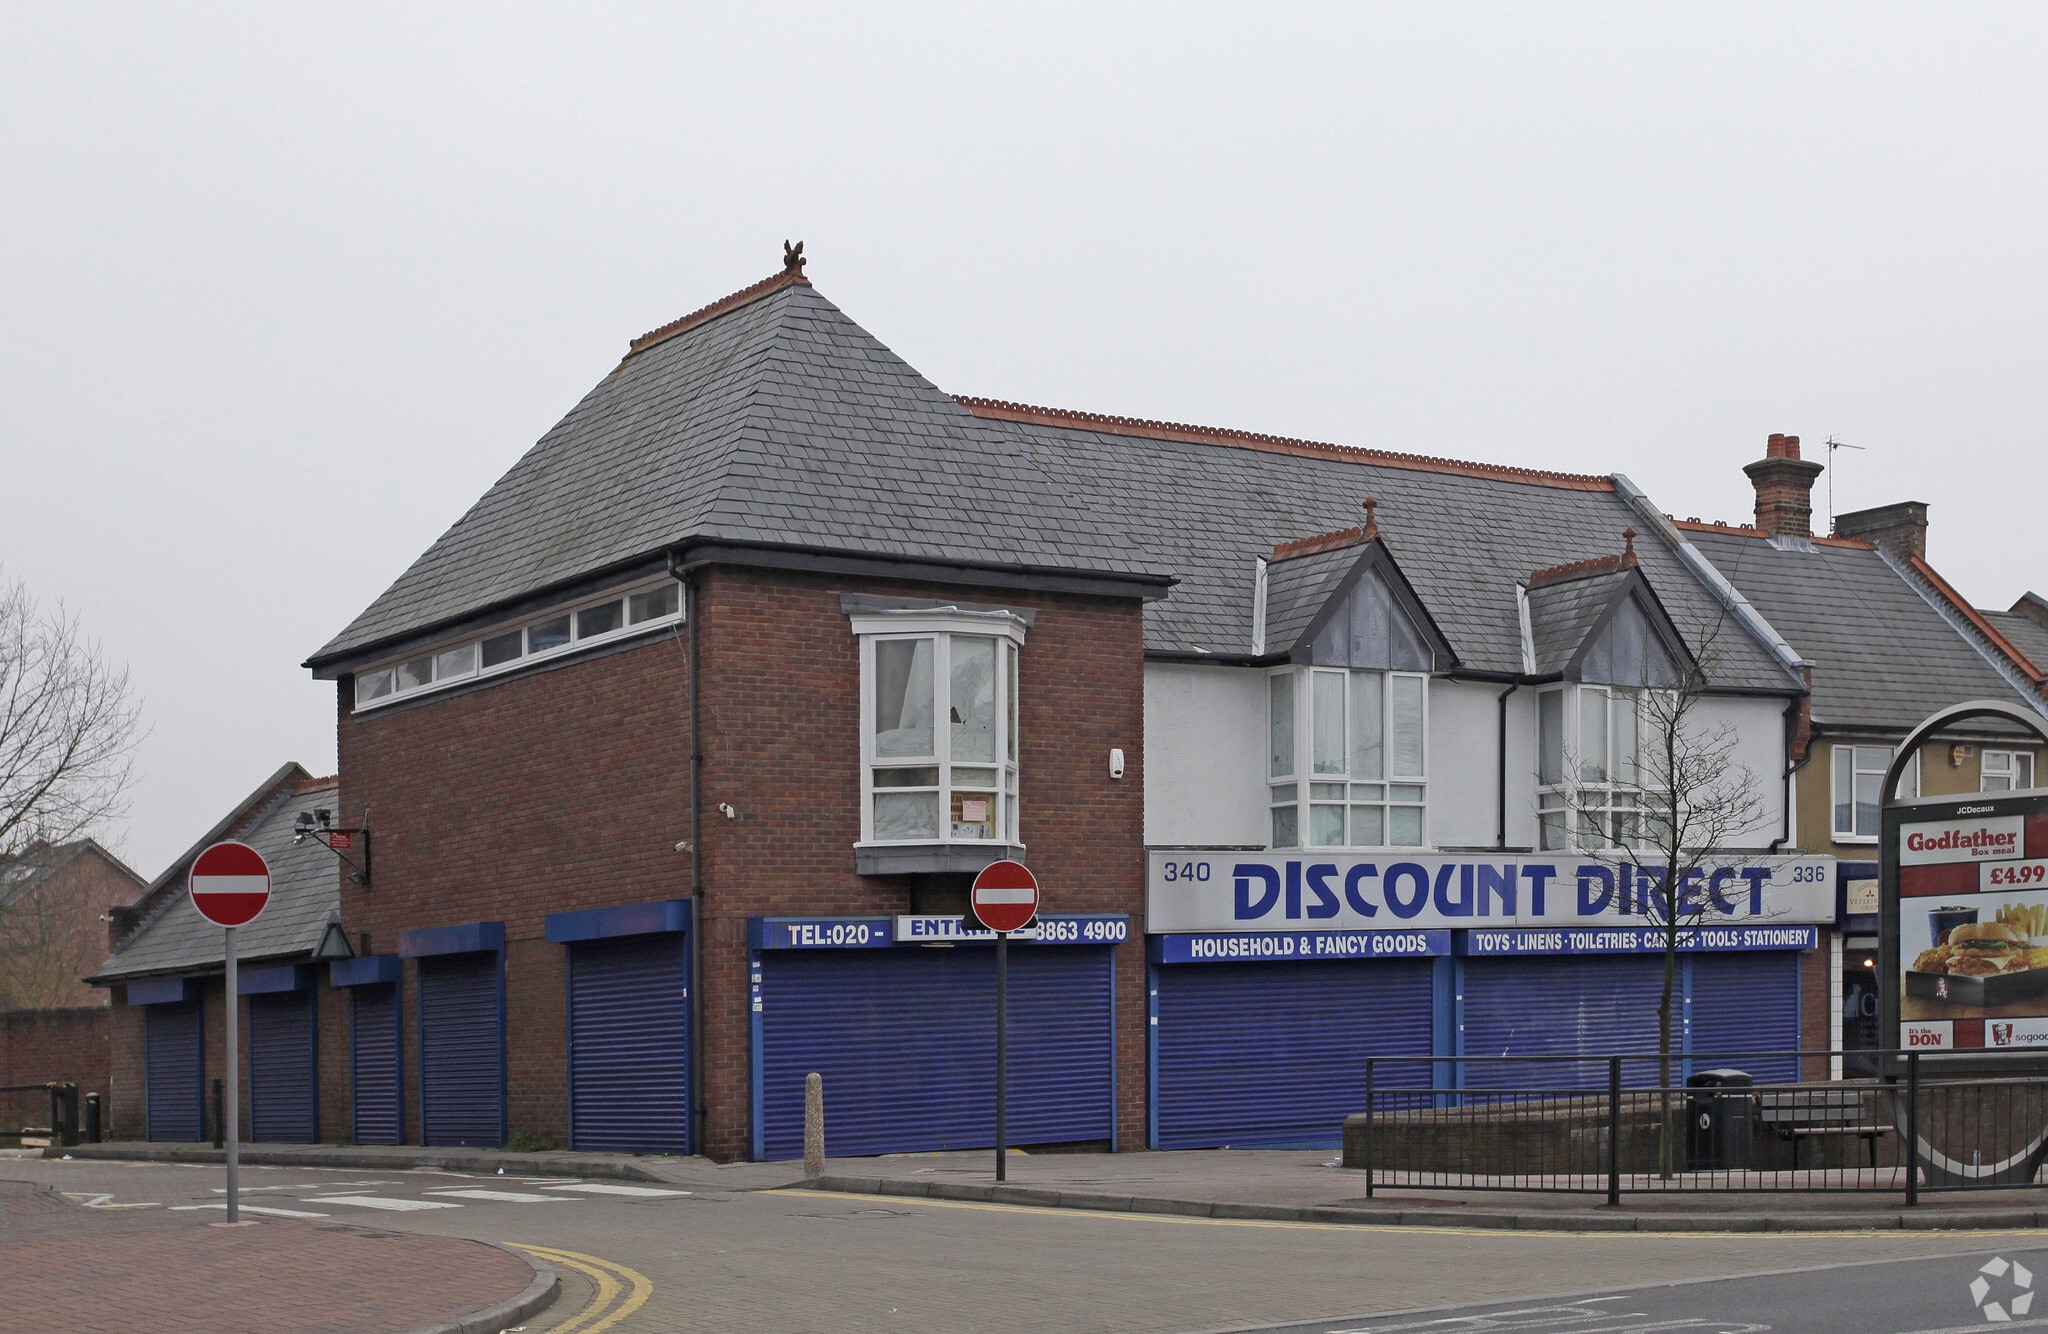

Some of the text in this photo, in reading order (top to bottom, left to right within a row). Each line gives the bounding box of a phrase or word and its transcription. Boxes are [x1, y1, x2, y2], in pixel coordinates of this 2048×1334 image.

[1957, 806, 1995, 815] JCDecaux
[1907, 828, 2017, 852] Godfather
[1971, 846, 2015, 856] Box meal
[1164, 862, 1210, 882] 340
[1793, 866, 1825, 883] 336
[1989, 865, 2046, 885] £4.99
[1232, 861, 1773, 922] DISCOUNT DIRECT
[788, 924, 869, 945] TEL:020
[1037, 921, 1127, 941] 8863 4900
[1476, 929, 1810, 951] TOYS LINENS TOILETRIES CARETS TOOLS STATIONERY
[1191, 934, 1427, 958] HOUSEHOLD & FANCY GOODS
[1909, 1034, 1942, 1046] DON
